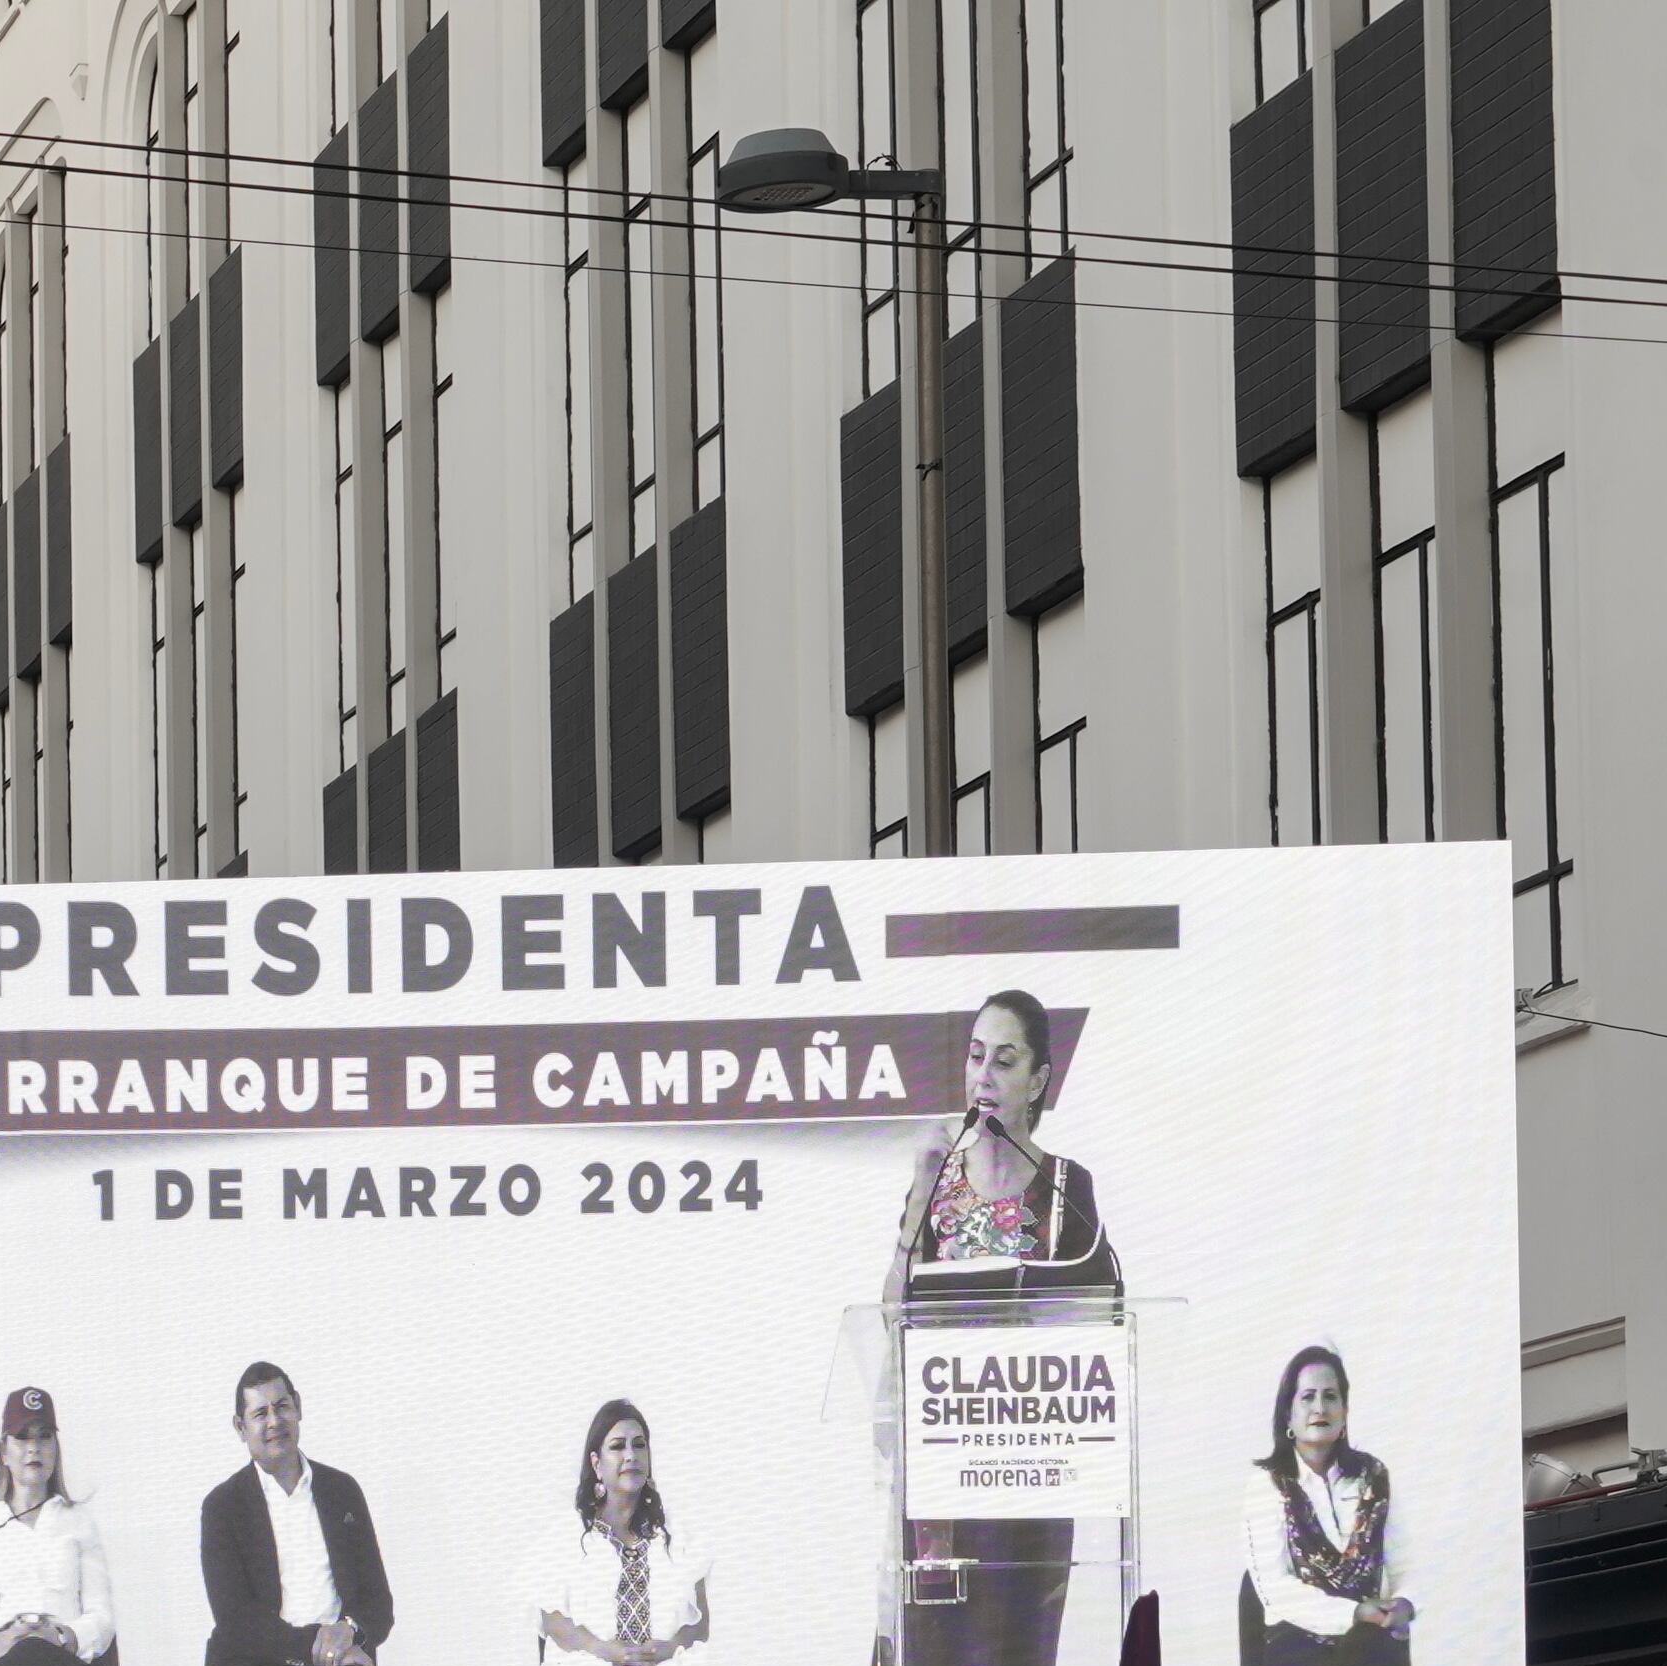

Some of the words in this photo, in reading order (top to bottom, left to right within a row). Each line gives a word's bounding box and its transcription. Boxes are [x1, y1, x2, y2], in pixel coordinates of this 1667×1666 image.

[405, 1055, 496, 1110] DE
[531, 1030, 907, 1108] CAMPAÑA
[92, 1168, 115, 1221] 1
[155, 1168, 244, 1221] DE
[282, 1164, 542, 1219] MARZO
[580, 1160, 763, 1214] 2024
[921, 1354, 1116, 1395] CLAUDIA
[921, 1396, 1116, 1426] SHEINBAUM
[961, 1433, 1075, 1447] PRESIDENTA
[960, 1468, 1042, 1487] morena
